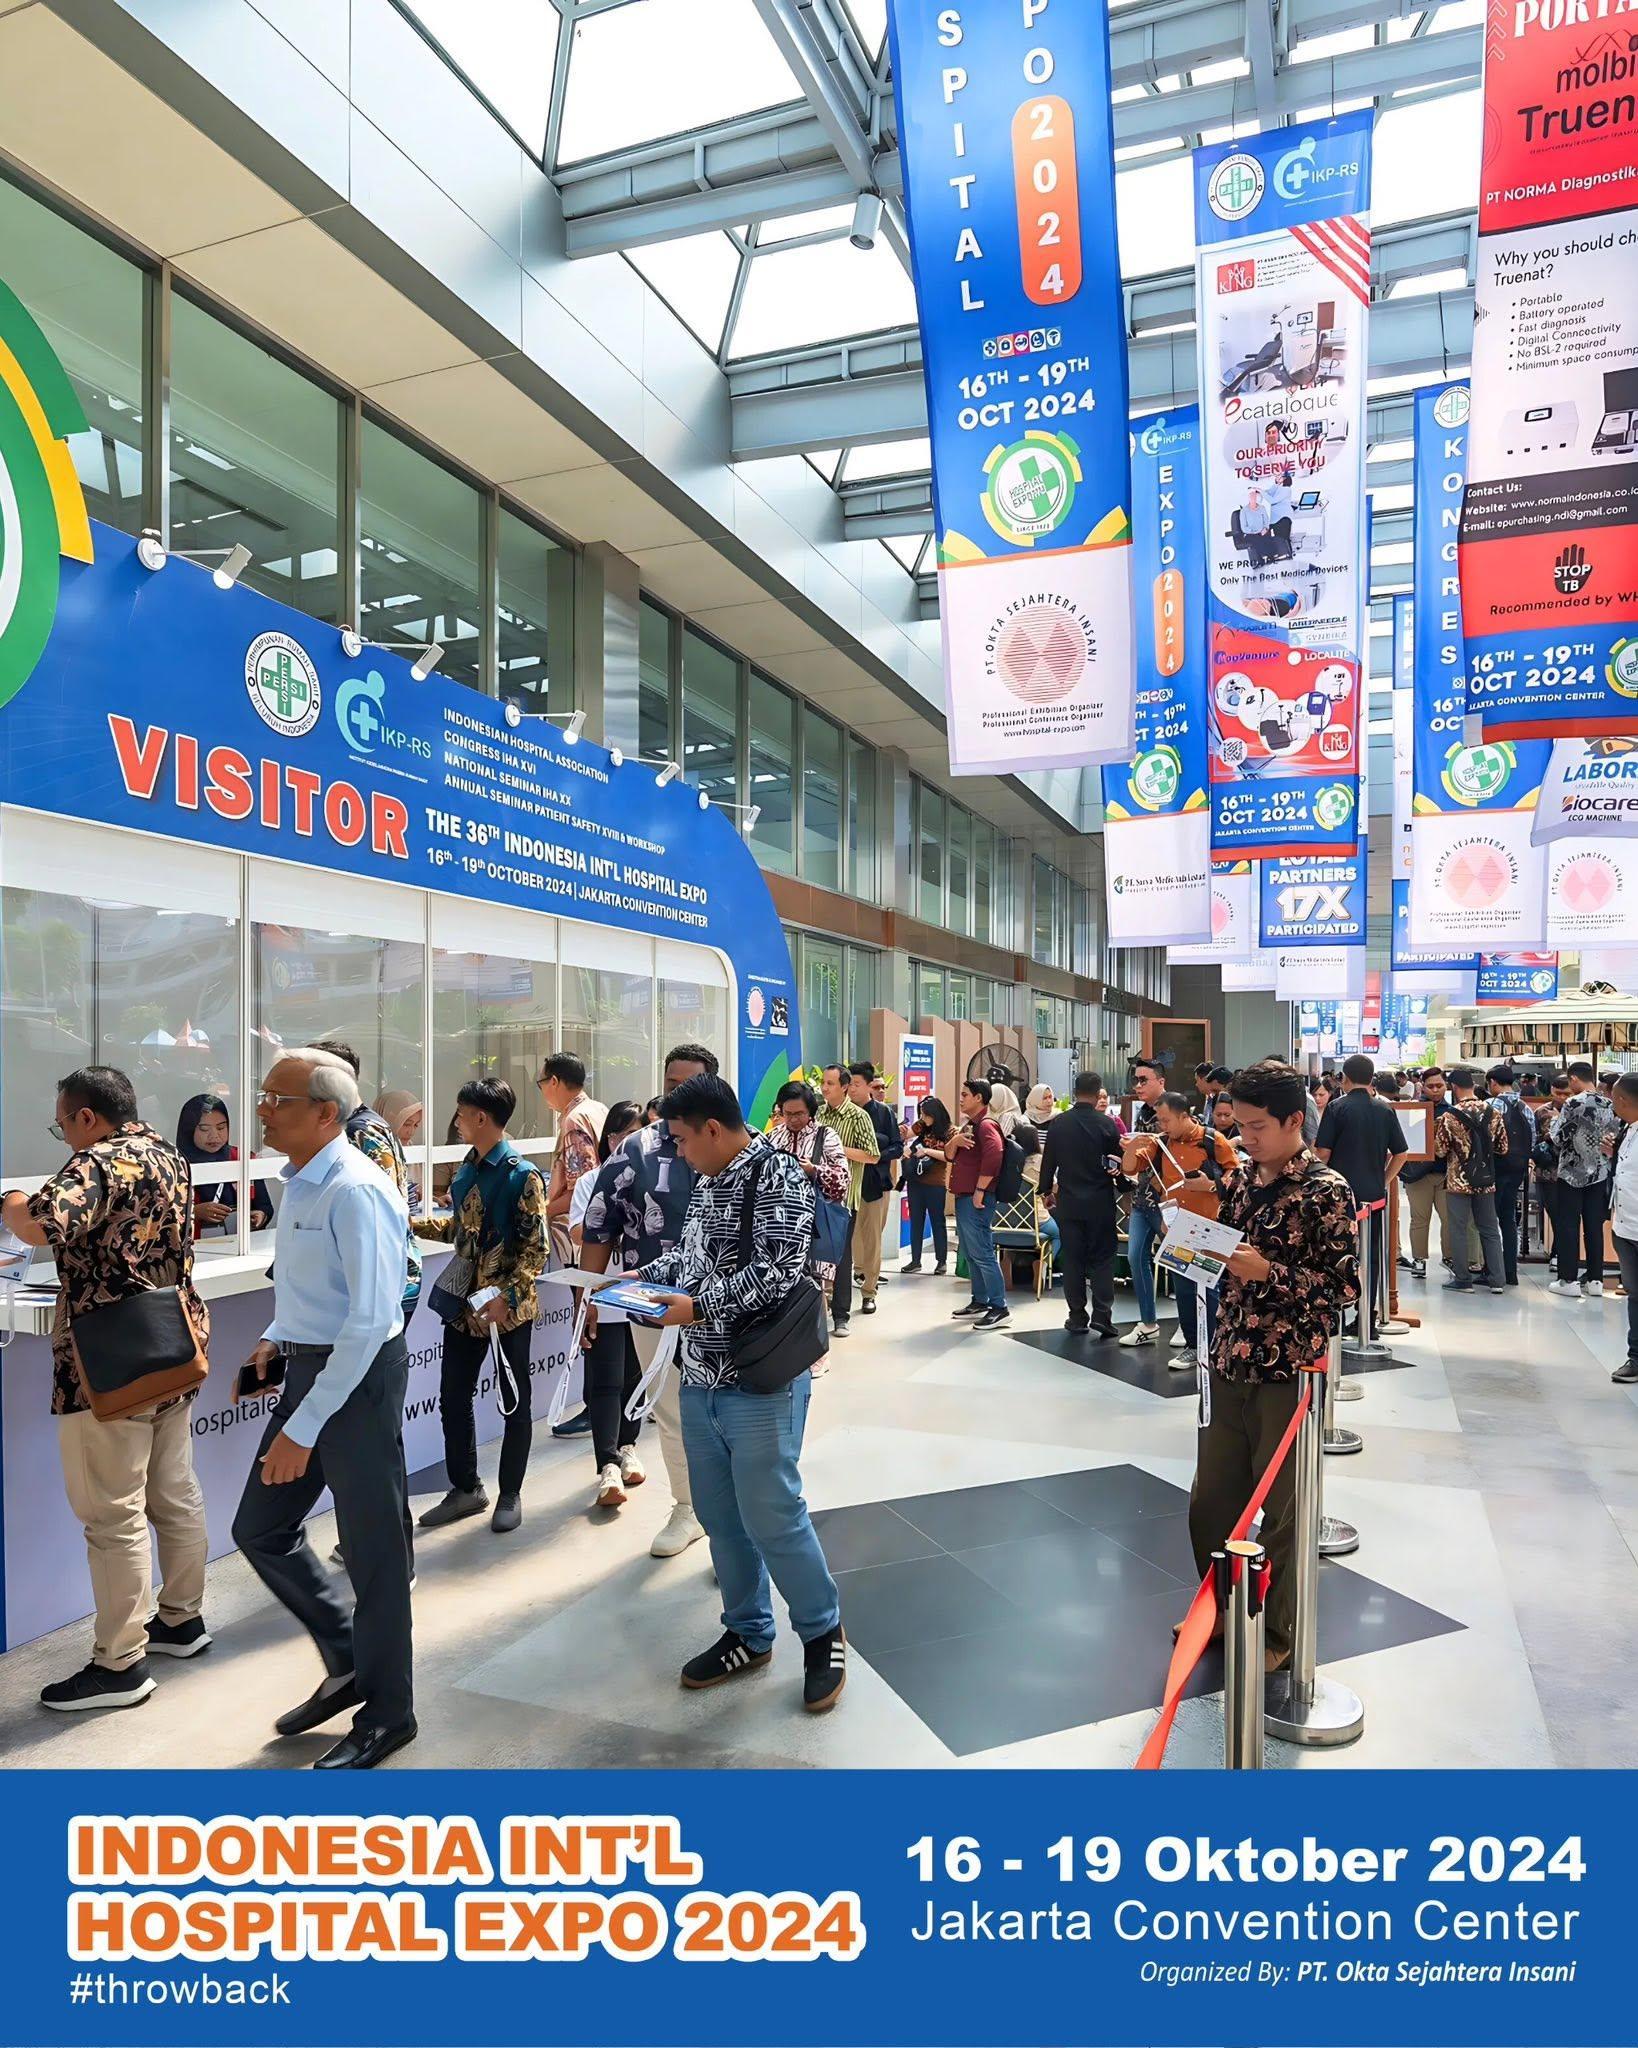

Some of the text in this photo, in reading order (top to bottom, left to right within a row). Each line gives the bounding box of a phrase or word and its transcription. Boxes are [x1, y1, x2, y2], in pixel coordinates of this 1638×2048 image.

[1517, 94, 1636, 142] Truen
[1310, 161, 1360, 184] IKP-RS
[1486, 165, 1638, 205] PT NORMA Diagnostik
[1029, 103, 1065, 297] 2024
[1494, 229, 1638, 267] Why you should ch
[1493, 264, 1555, 287] Truenat?
[1519, 292, 1563, 307] Portable
[1519, 297, 1605, 322] Battery operated
[1518, 315, 1586, 334] Fast diagnosis
[1517, 332, 1550, 347] Digital
[1517, 336, 1607, 359] No BSL-2 required
[1515, 359, 1559, 372] Minimum
[1561, 353, 1592, 367] space
[957, 356, 1090, 400] 16TH - 19TH
[957, 388, 1096, 431] OCT 2024
[1224, 393, 1339, 425] ecatalogue
[1162, 431, 1193, 445] IKP-RS
[1235, 438, 1326, 461] OUR PRIORITY
[1234, 454, 1326, 479] TO SERVE YOU
[1467, 482, 1523, 498] Contact Us:
[1463, 504, 1628, 533] E-mail: epurchasing.ndi@gmail.com
[1464, 502, 1508, 516] Website:
[1440, 436, 1465, 666] KONGRES
[1158, 464, 1175, 672] EXPO 2024
[1218, 560, 1235, 571] WE
[1219, 574, 1240, 587] Only
[1241, 573, 1258, 584] The
[1258, 570, 1279, 583] Best
[1315, 563, 1349, 577] Devices
[1553, 563, 1592, 579] STOP
[1562, 579, 1580, 593] TB
[1490, 594, 1613, 616] Recommended by
[1006, 592, 1097, 663] SEJAHTERA INSANI
[1471, 644, 1595, 674] 16TH - 19TH
[1470, 671, 1517, 695] OCT
[1525, 665, 1596, 688] 2024
[1497, 693, 1563, 706] CONVENTION
[1564, 691, 1606, 702] CENTER
[982, 707, 1028, 720] Professional
[1030, 705, 1068, 716] Exhibition
[982, 717, 1028, 729] Professional
[1028, 714, 1069, 726] Conference
[1163, 702, 1186, 721] 19TH
[380, 725, 432, 760] IKP-RS
[1154, 721, 1189, 741] 2024
[444, 707, 609, 784] INDONESIAN HOSPITAL ASSOCIATION
[444, 730, 537, 775] CONGRESS IHA XVI
[107, 712, 410, 860] VISITOR
[444, 752, 498, 782] NATIONAL
[499, 772, 542, 796] SEMINAR
[542, 786, 559, 802] IHA
[559, 793, 573, 807] XX
[1220, 791, 1306, 811] 16TH 19TH
[444, 774, 489, 799] ANNUAL
[490, 788, 534, 815] SEMINAR
[534, 804, 571, 826] PATIENT
[571, 815, 601, 835] SAFETY
[620, 833, 626, 843] &
[626, 835, 666, 855] WORKSHOP
[1219, 806, 1308, 826] OCT 2024
[1586, 814, 1622, 822] MACHINE
[1215, 824, 1315, 837] JAKARTA CONVENTION CENTER
[425, 807, 708, 905] THE 36TH INDONESIA INT'L HOSPITAL EXPO
[427, 847, 709, 928] 16th 19th OCTOBER 2024 JAKARTA CONVENTION CENTER
[1269, 867, 1357, 885] PARTNERS
[1276, 885, 1352, 922] 17X
[1266, 922, 1360, 936] PARTICIPATED
[1480, 979, 1527, 988] OCT 2024
